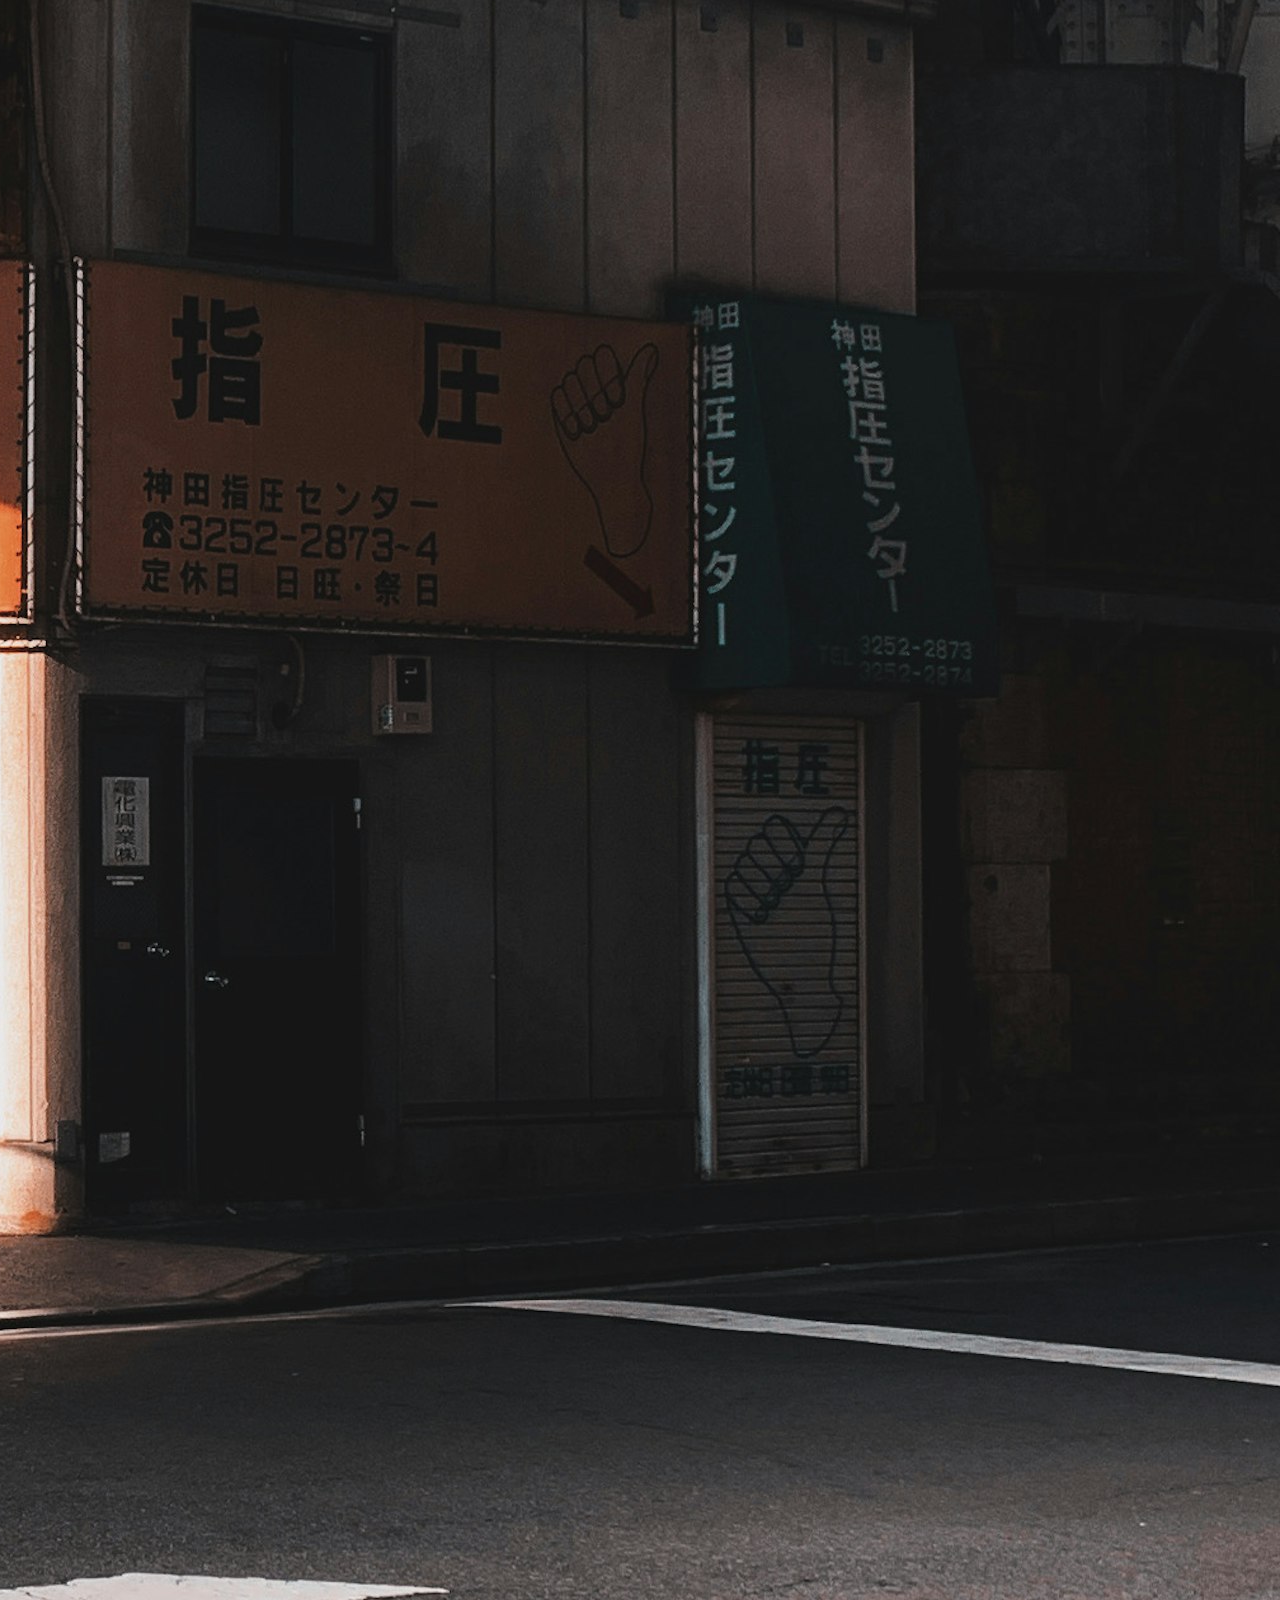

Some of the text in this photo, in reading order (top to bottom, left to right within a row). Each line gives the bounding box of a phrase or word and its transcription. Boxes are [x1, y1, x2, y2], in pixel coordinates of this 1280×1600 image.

[830, 318, 882, 352] 神田
[171, 296, 502, 444] 指圧
[143, 467, 438, 519] 神田指圧センター
[841, 357, 908, 613] 指圧センター
[142, 558, 238, 597] 定休日
[817, 634, 973, 667] TEL 3252-2873
[858, 661, 973, 686] 3252-2874
